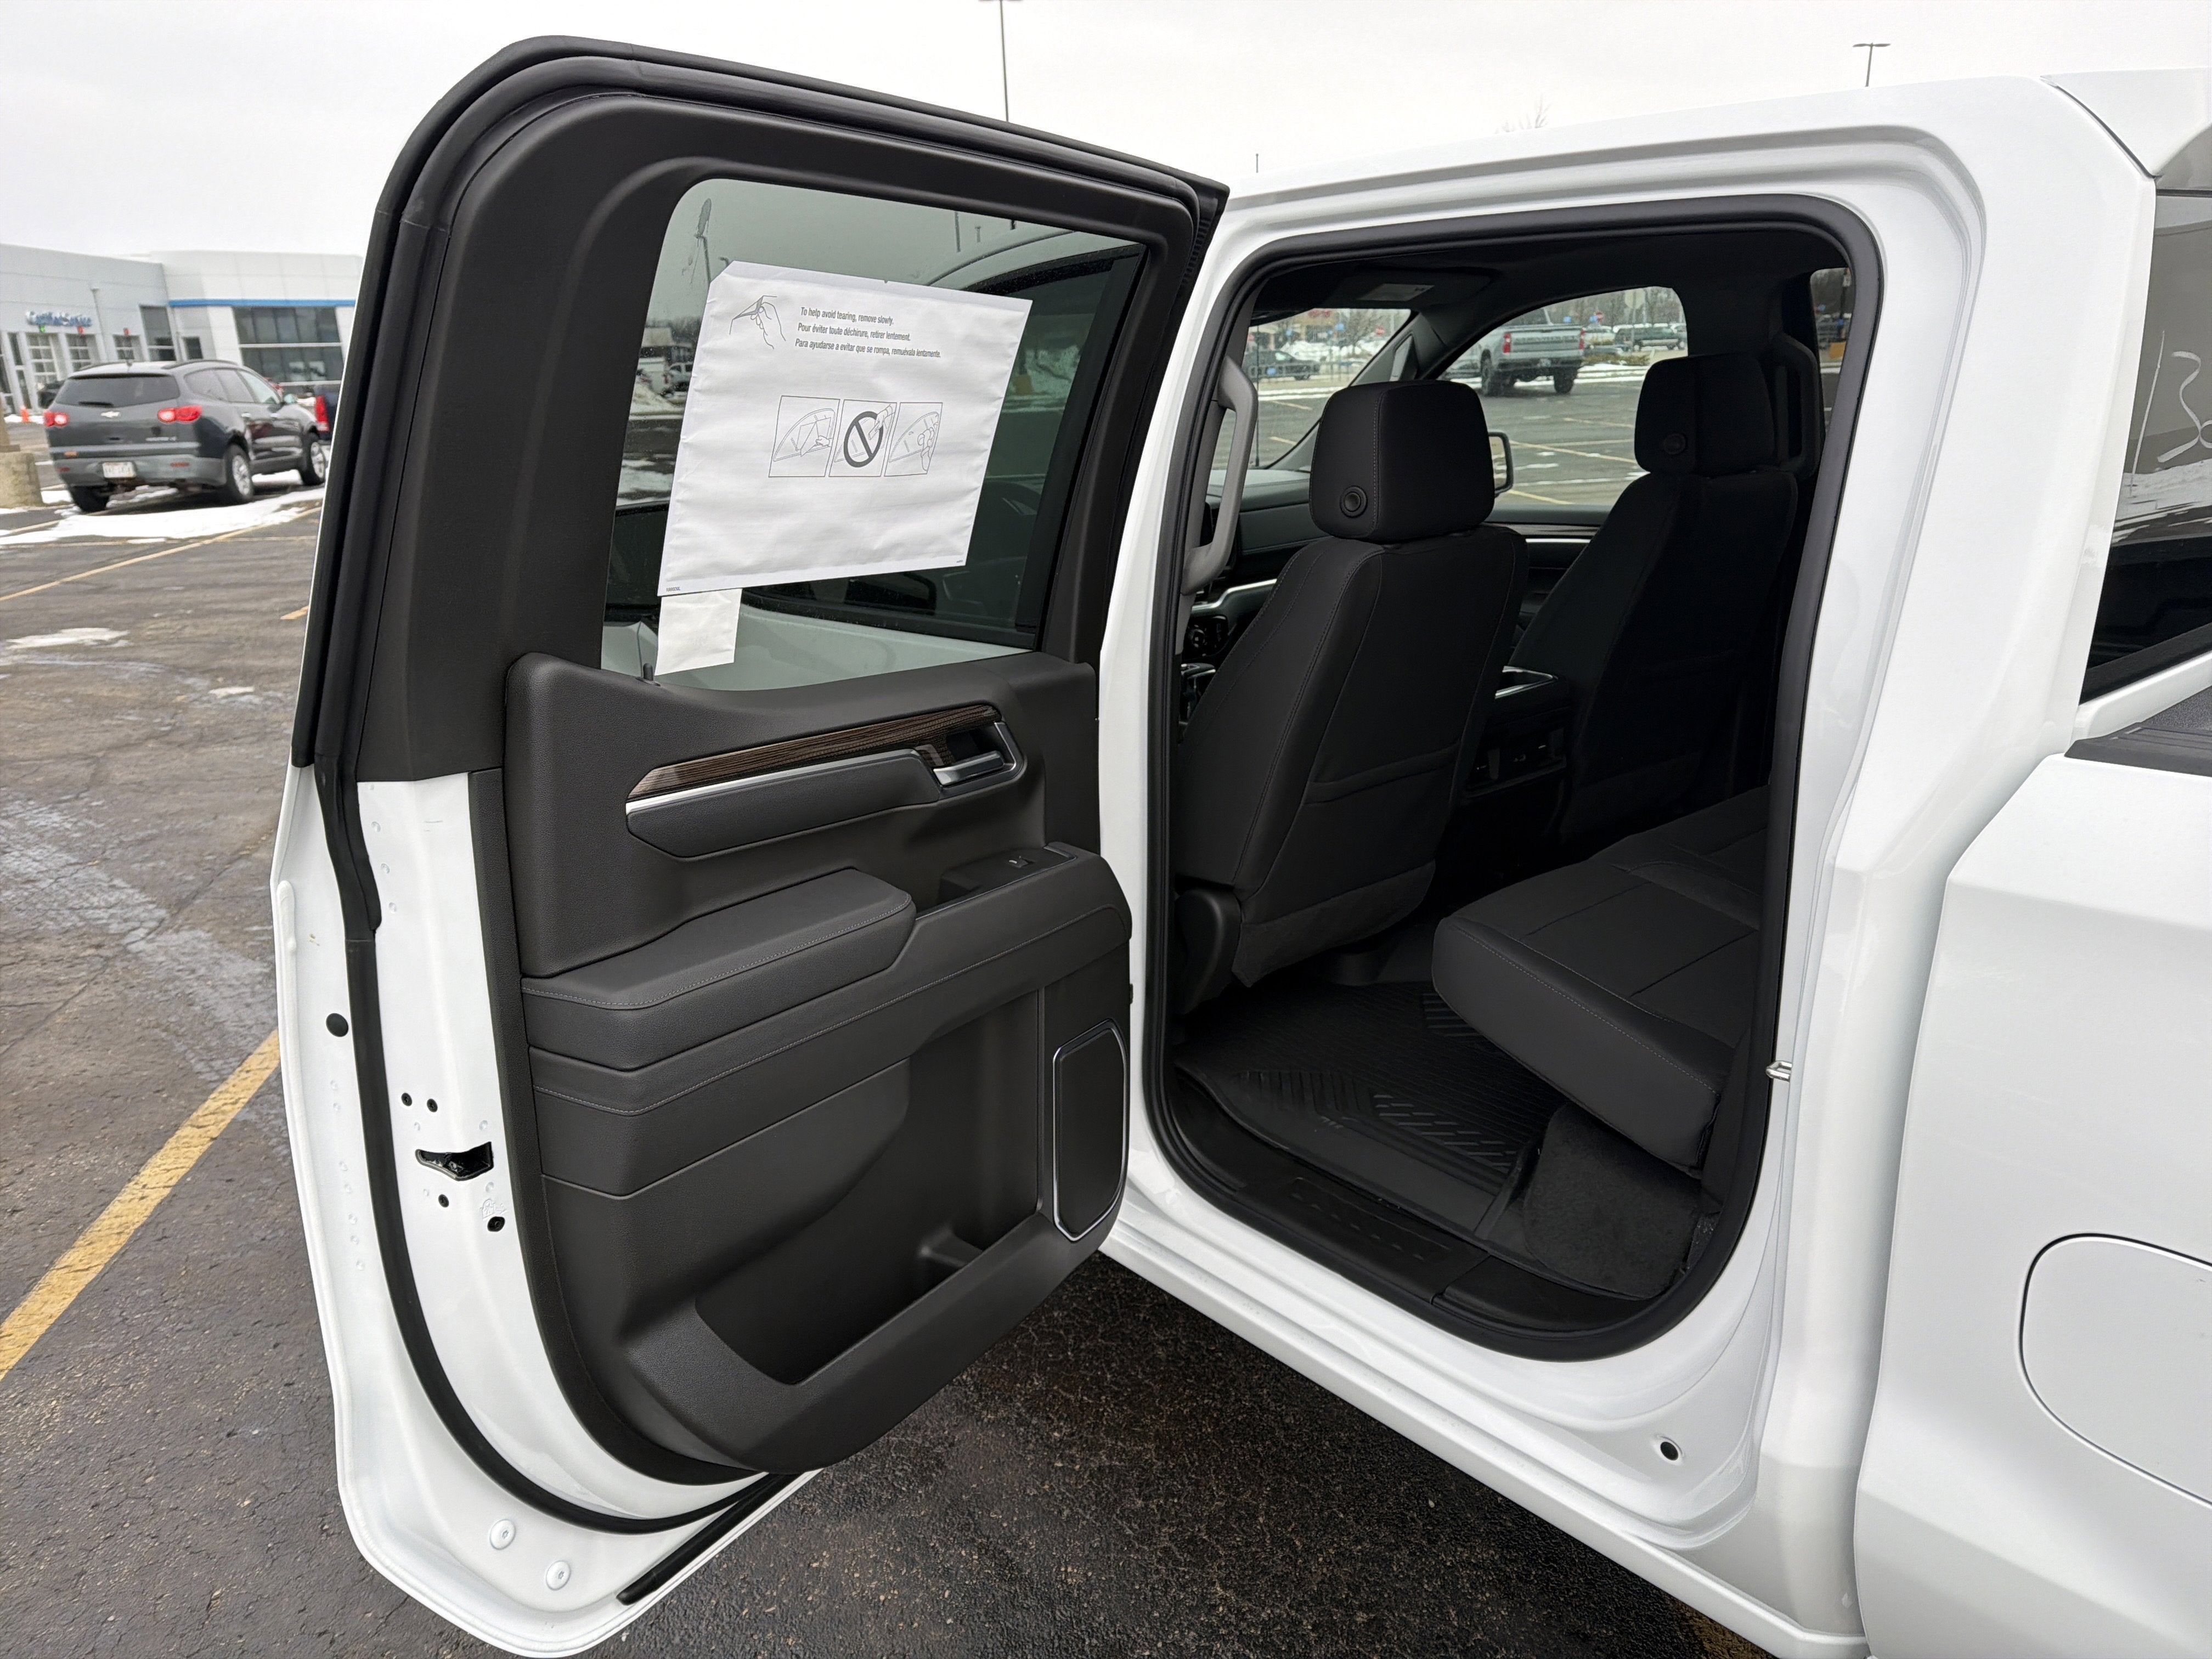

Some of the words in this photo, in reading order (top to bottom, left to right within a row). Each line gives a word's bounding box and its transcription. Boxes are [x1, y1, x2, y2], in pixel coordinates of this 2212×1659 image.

[801, 307, 807, 315] To
[809, 309, 820, 318] help
[822, 309, 836, 319] avoid
[837, 312, 857, 322] tearing,
[878, 316, 894, 326] slowly.
[798, 323, 810, 332] Pour
[812, 324, 828, 334] éviter
[829, 326, 843, 335] toute
[844, 327, 869, 338] déchirure,
[870, 330, 885, 338] retirer
[887, 331, 910, 341] lentement.
[795, 338, 808, 347] Para
[809, 341, 834, 352] ayudarse
[840, 343, 855, 352] evitar
[891, 347, 916, 356] remuévala
[916, 349, 940, 358] lentamente.
